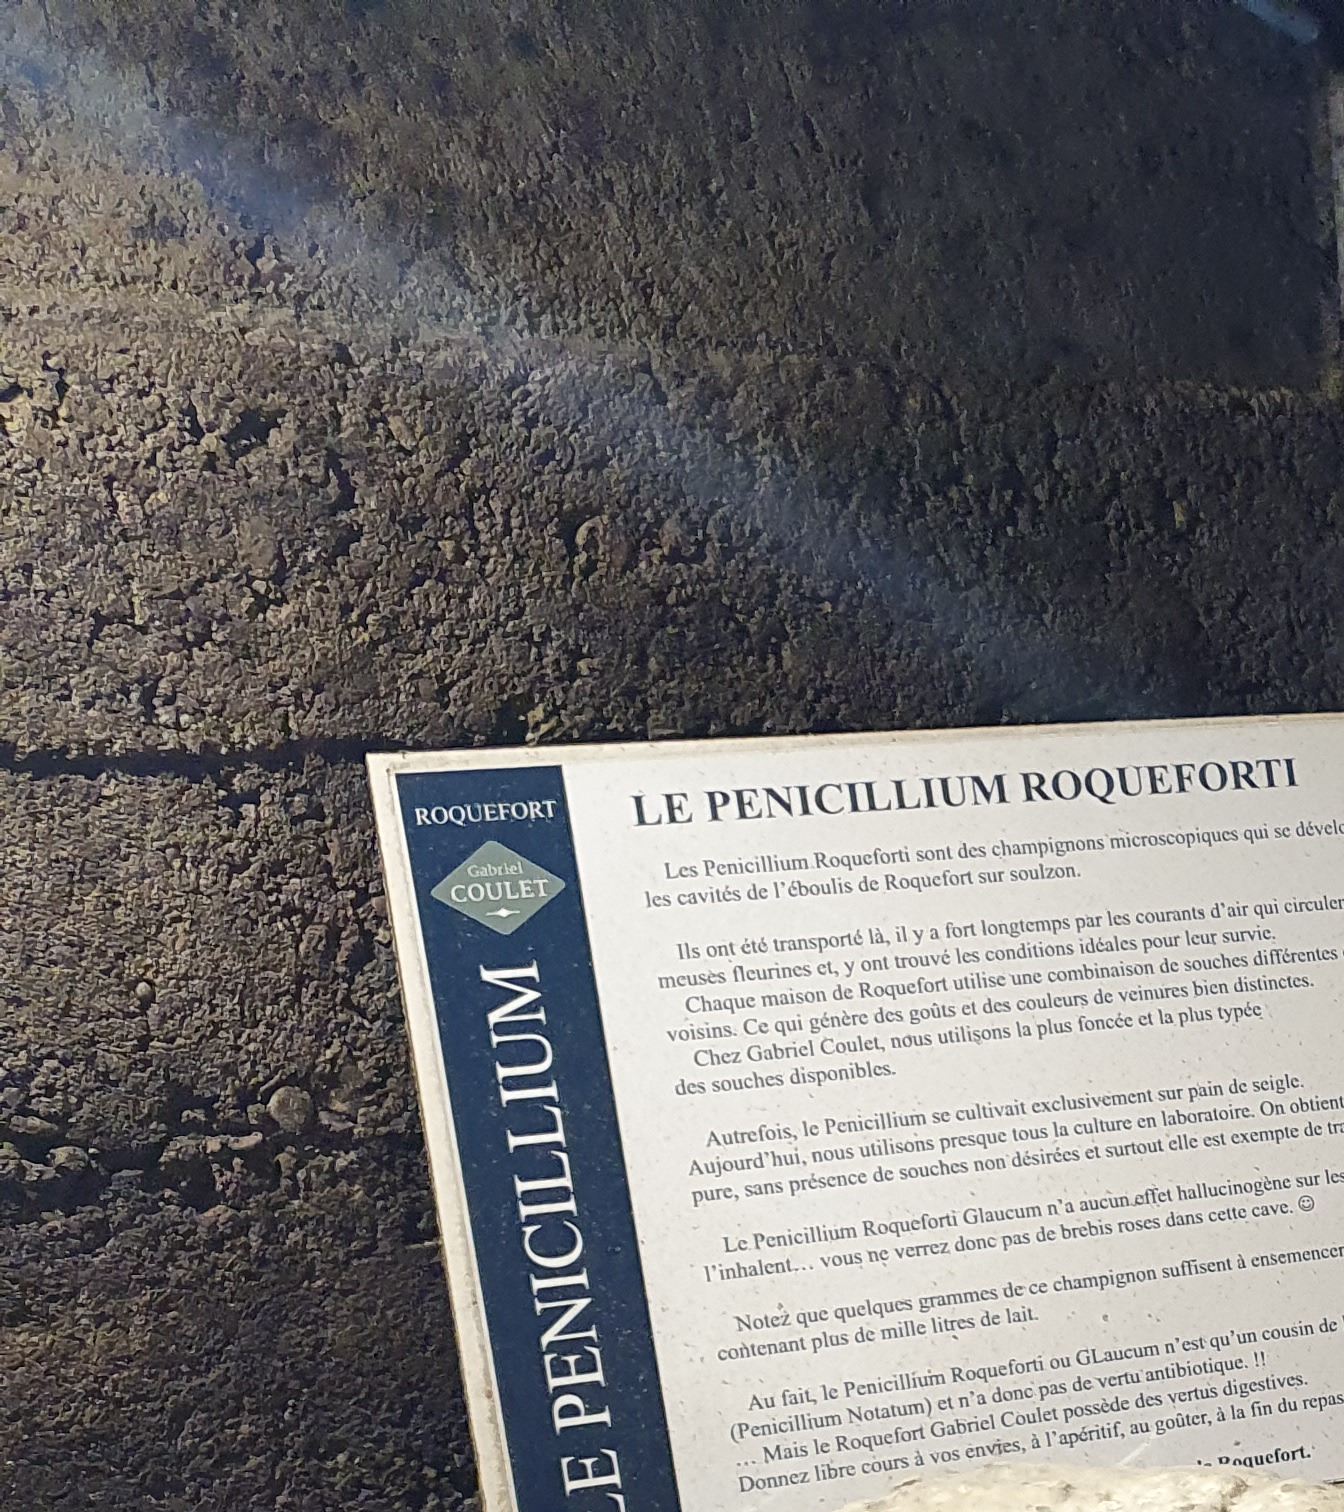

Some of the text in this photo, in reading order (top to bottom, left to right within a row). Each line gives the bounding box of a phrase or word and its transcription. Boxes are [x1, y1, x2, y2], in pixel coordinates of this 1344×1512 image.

[415, 799, 556, 827] ROQUEFORT
[629, 757, 1299, 827] LE PENICILLIUM ROQUEFORTI
[467, 861, 523, 878] Gabriel
[663, 861, 699, 880] Les
[701, 853, 810, 877] Penicillium
[812, 845, 911, 872] Roqueforti
[915, 845, 954, 863] sont
[956, 841, 987, 859] des
[990, 835, 1105, 863] champignons
[1108, 826, 1239, 850] microscopiques
[1242, 822, 1270, 845] qui
[1273, 825, 1292, 839] se
[450, 879, 549, 903] COULET
[643, 862, 1081, 908] les cavités de l’éboulis de Roquefort sur soulzon.
[657, 923, 1276, 989] meuses fleurines et, y ont trouvé les conditions idéales pour leur survie.
[684, 994, 757, 1015] Chaque
[760, 986, 828, 1008] maison
[831, 982, 854, 1001] de
[857, 975, 949, 1001] Roquefort
[952, 970, 1007, 991] utilise
[1008, 971, 1043, 986] une
[1046, 959, 1155, 984] combinaison
[1158, 956, 1180, 974] de
[1182, 951, 1249, 972] souches
[1252, 946, 1339, 967] différentes
[692, 1000, 1264, 1067] Chez Gabriel Coulet, nous utilisons la plus foncée et la plus typée
[673, 1059, 897, 1096] des souches disponibles.
[705, 1072, 1305, 1148] Autrefois, le Penicillium se cultivait exclusivement sur pain de seigle.
[690, 1186, 740, 1208] pure,
[743, 1180, 784, 1198] sans
[787, 1171, 868, 1197] présence
[871, 1164, 895, 1183] de
[898, 1158, 969, 1181] souches
[972, 1156, 1007, 1172] non
[1010, 1145, 1081, 1168] désirées
[1083, 1140, 1102, 1160] et
[1104, 1137, 1165, 1158] surtout
[1166, 1131, 1199, 1152] elle
[1201, 1132, 1227, 1148] est
[1229, 1125, 1300, 1145] exempte
[1302, 1120, 1323, 1137] de
[479, 960, 612, 1436] PENICILLIUM
[733, 1307, 792, 1333] Notez
[795, 1308, 830, 1329] que
[833, 1297, 914, 1324] quelques
[917, 1287, 999, 1314] grammes
[1001, 1280, 1027, 1299] de
[1027, 1281, 1049, 1296] ce
[1052, 1268, 1158, 1292] champignon
[1160, 1257, 1234, 1279] suffisent
[1236, 1252, 1247, 1270] à
[716, 1304, 1039, 1362] contenant plus de mille litres de lait.
[747, 1393, 776, 1412] Au
[780, 1386, 818, 1407] fait,
[820, 1383, 839, 1401] le
[842, 1368, 947, 1398] Penicillium
[949, 1354, 1045, 1384] Roqueforti
[1048, 1355, 1072, 1370] ou
[1163, 1335, 1207, 1355] n’est
[1208, 1329, 1258, 1352] qu’un
[1260, 1319, 1315, 1341] cousin
[1317, 1316, 1338, 1334] de
[761, 1440, 809, 1464] Mais
[812, 1437, 831, 1456] le
[834, 1423, 926, 1453] Roquefort
[929, 1412, 996, 1438] Gabriel
[999, 1405, 1059, 1428] Coulet
[1061, 1394, 1131, 1424] possède
[1133, 1391, 1164, 1409] des
[1166, 1380, 1219, 1404] vertus
[1221, 1373, 1308, 1399] digestives.
